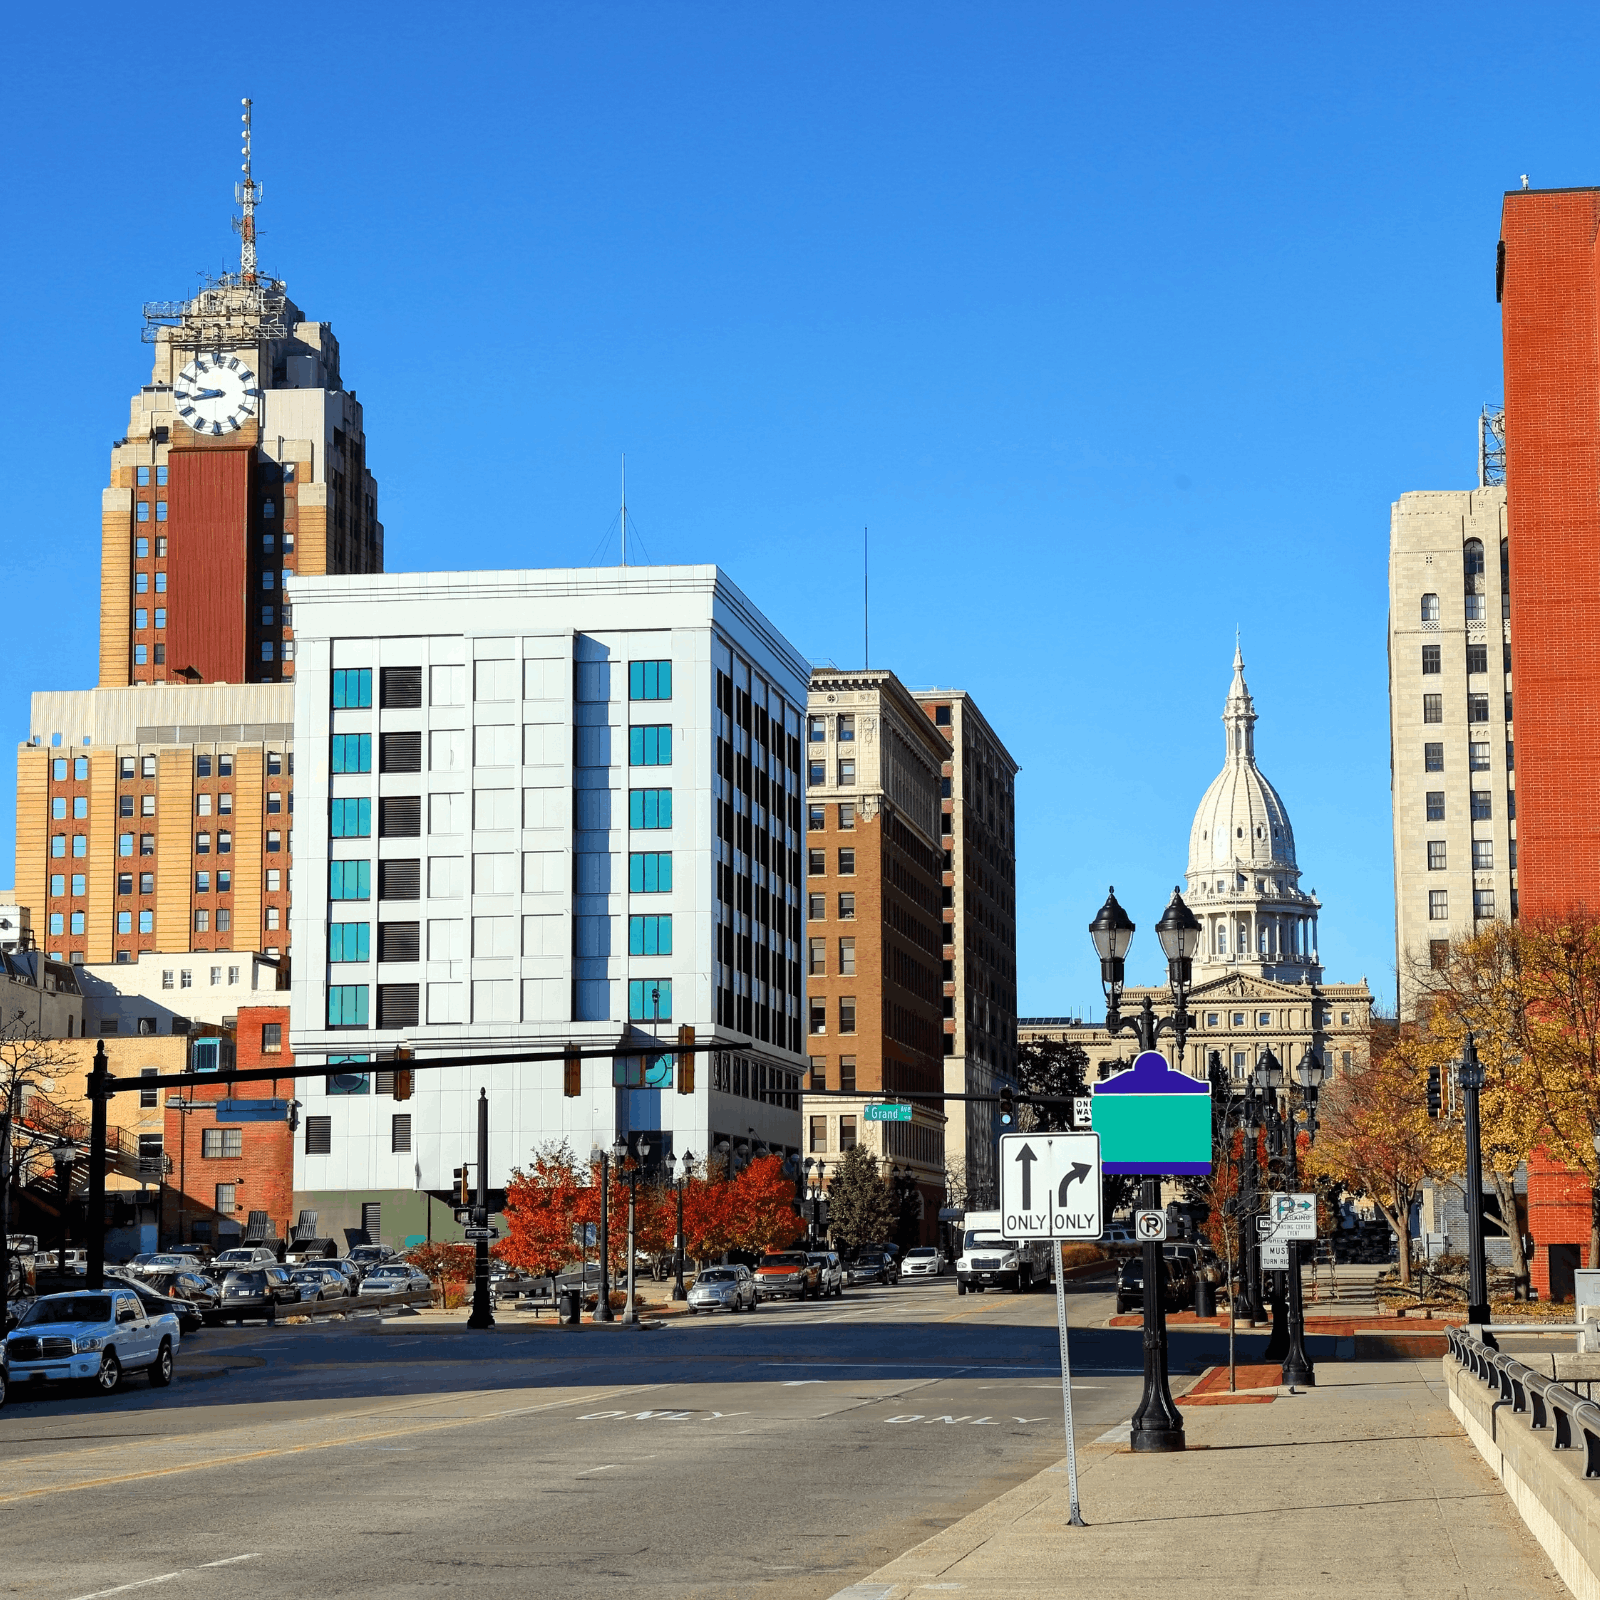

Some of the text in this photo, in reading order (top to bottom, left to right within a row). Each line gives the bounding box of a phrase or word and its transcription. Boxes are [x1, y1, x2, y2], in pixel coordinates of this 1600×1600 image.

[871, 1107, 898, 1119] Grand
[1007, 1215, 1046, 1230] ONLY
[1054, 1214, 1095, 1229] ONLY
[576, 1411, 751, 1420] ONLY
[884, 1415, 1050, 1425] ONLY
